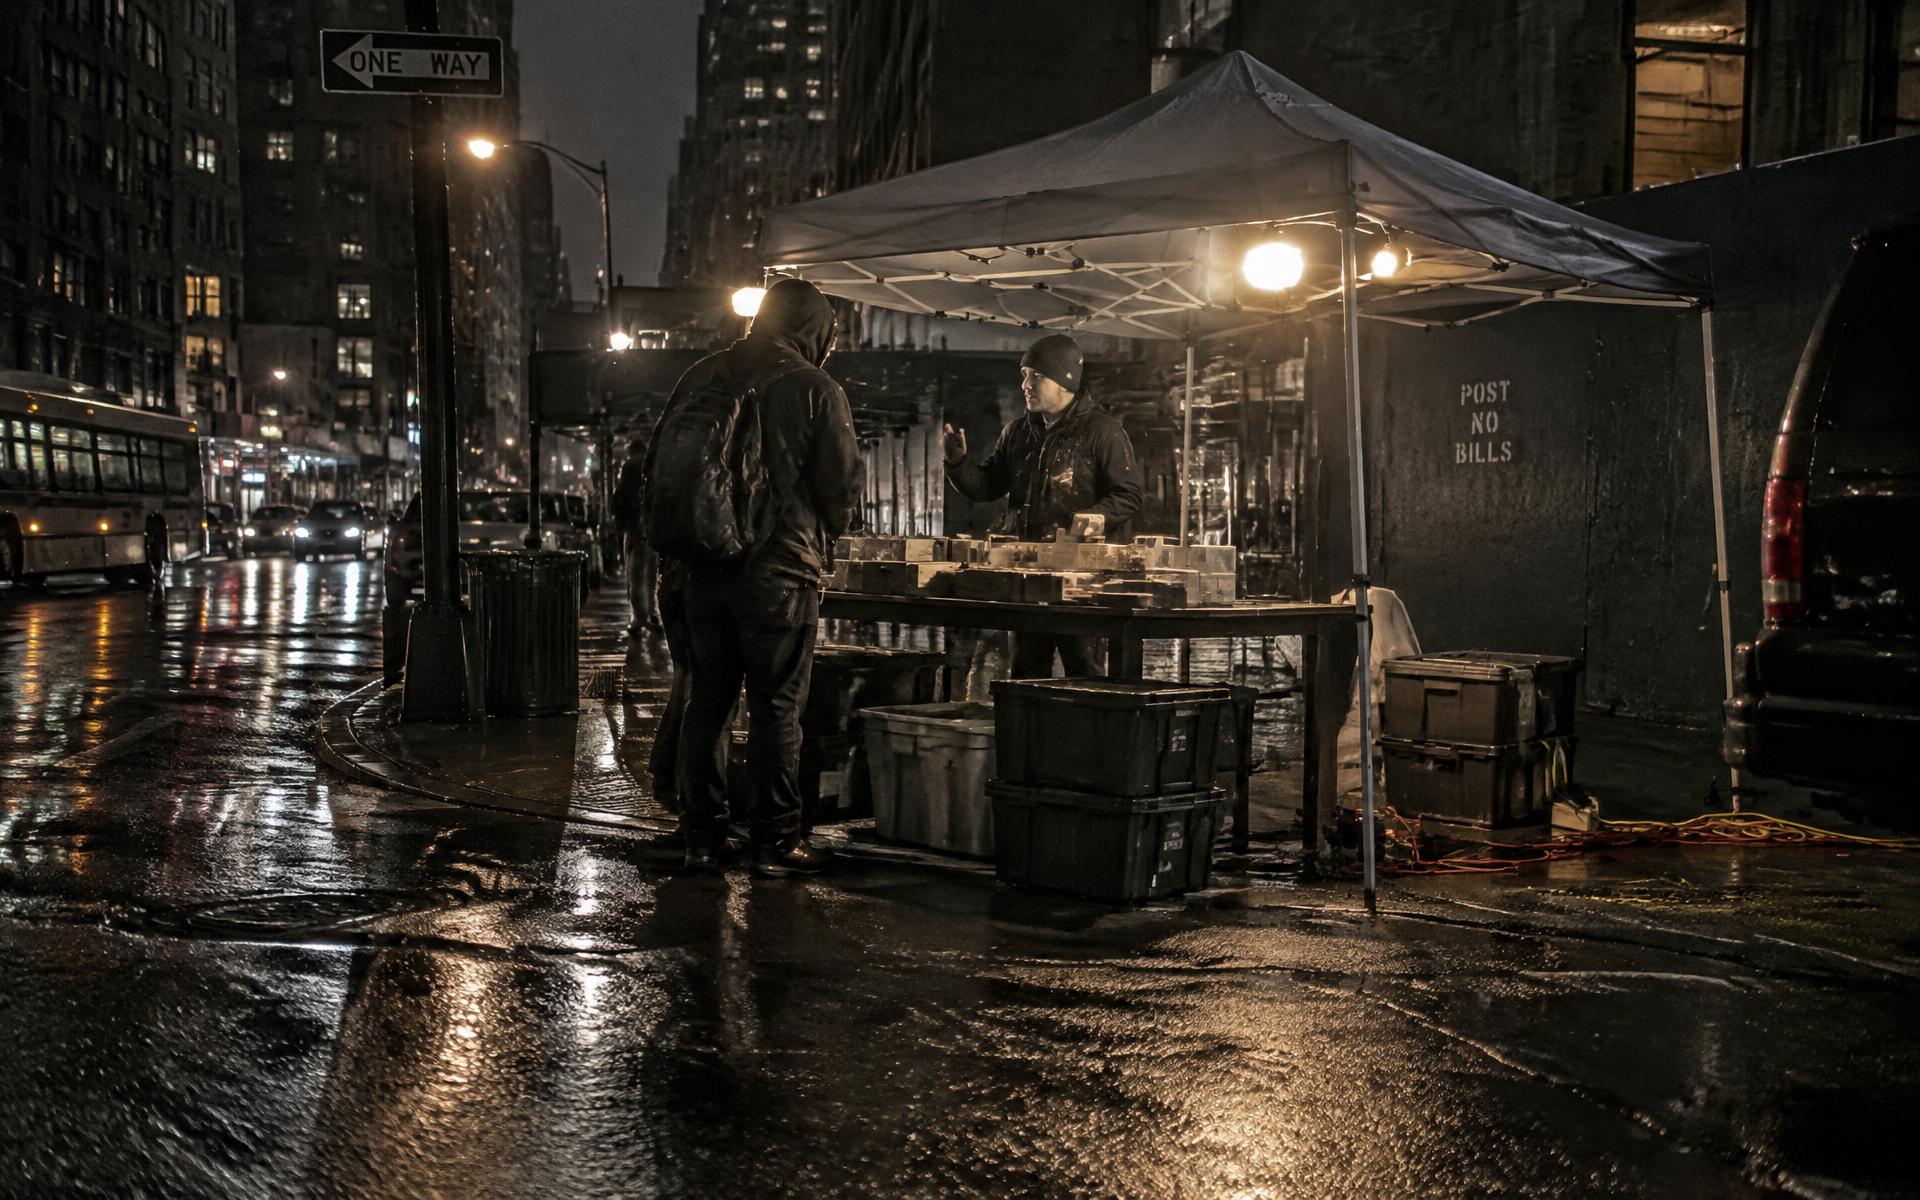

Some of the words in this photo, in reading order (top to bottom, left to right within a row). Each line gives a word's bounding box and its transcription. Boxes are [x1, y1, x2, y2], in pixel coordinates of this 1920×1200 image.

[350, 50, 402, 73] ONE
[431, 53, 482, 76] WAY
[1461, 380, 1510, 405] POST
[1471, 411, 1499, 435] NO
[1456, 441, 1511, 464] BILLS
